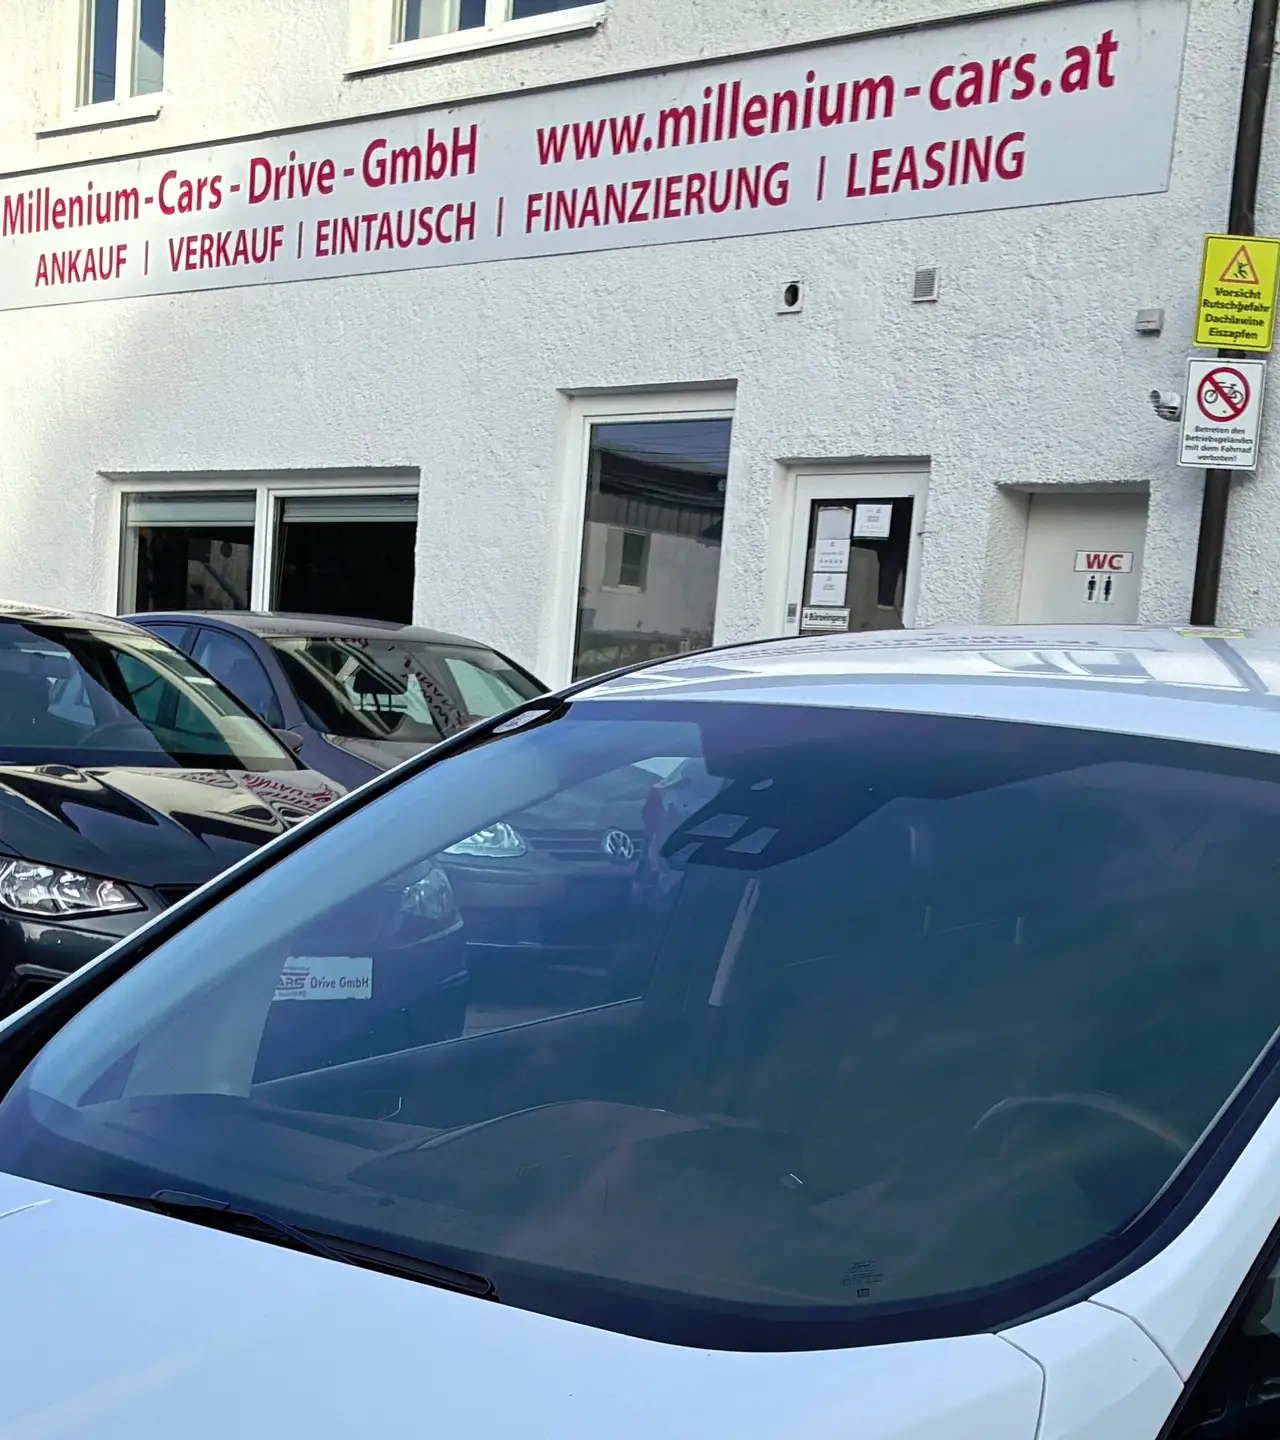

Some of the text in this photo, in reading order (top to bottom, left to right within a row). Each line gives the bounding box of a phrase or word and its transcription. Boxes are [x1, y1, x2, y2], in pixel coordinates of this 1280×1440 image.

[536, 28, 1119, 166] www.millenium-cars.at
[34, 131, 1026, 288] ANKAUF VERKAUF EINTAUSCH FINANZIERUNG LEASING
[1214, 287, 1262, 300] Vorsicht
[1202, 298, 1271, 313] Rutschgefahr
[1208, 327, 1259, 343] Eiszapfen
[1085, 553, 1124, 571] WC
[310, 976, 336, 989] Drive
[339, 976, 370, 989] GmbH
